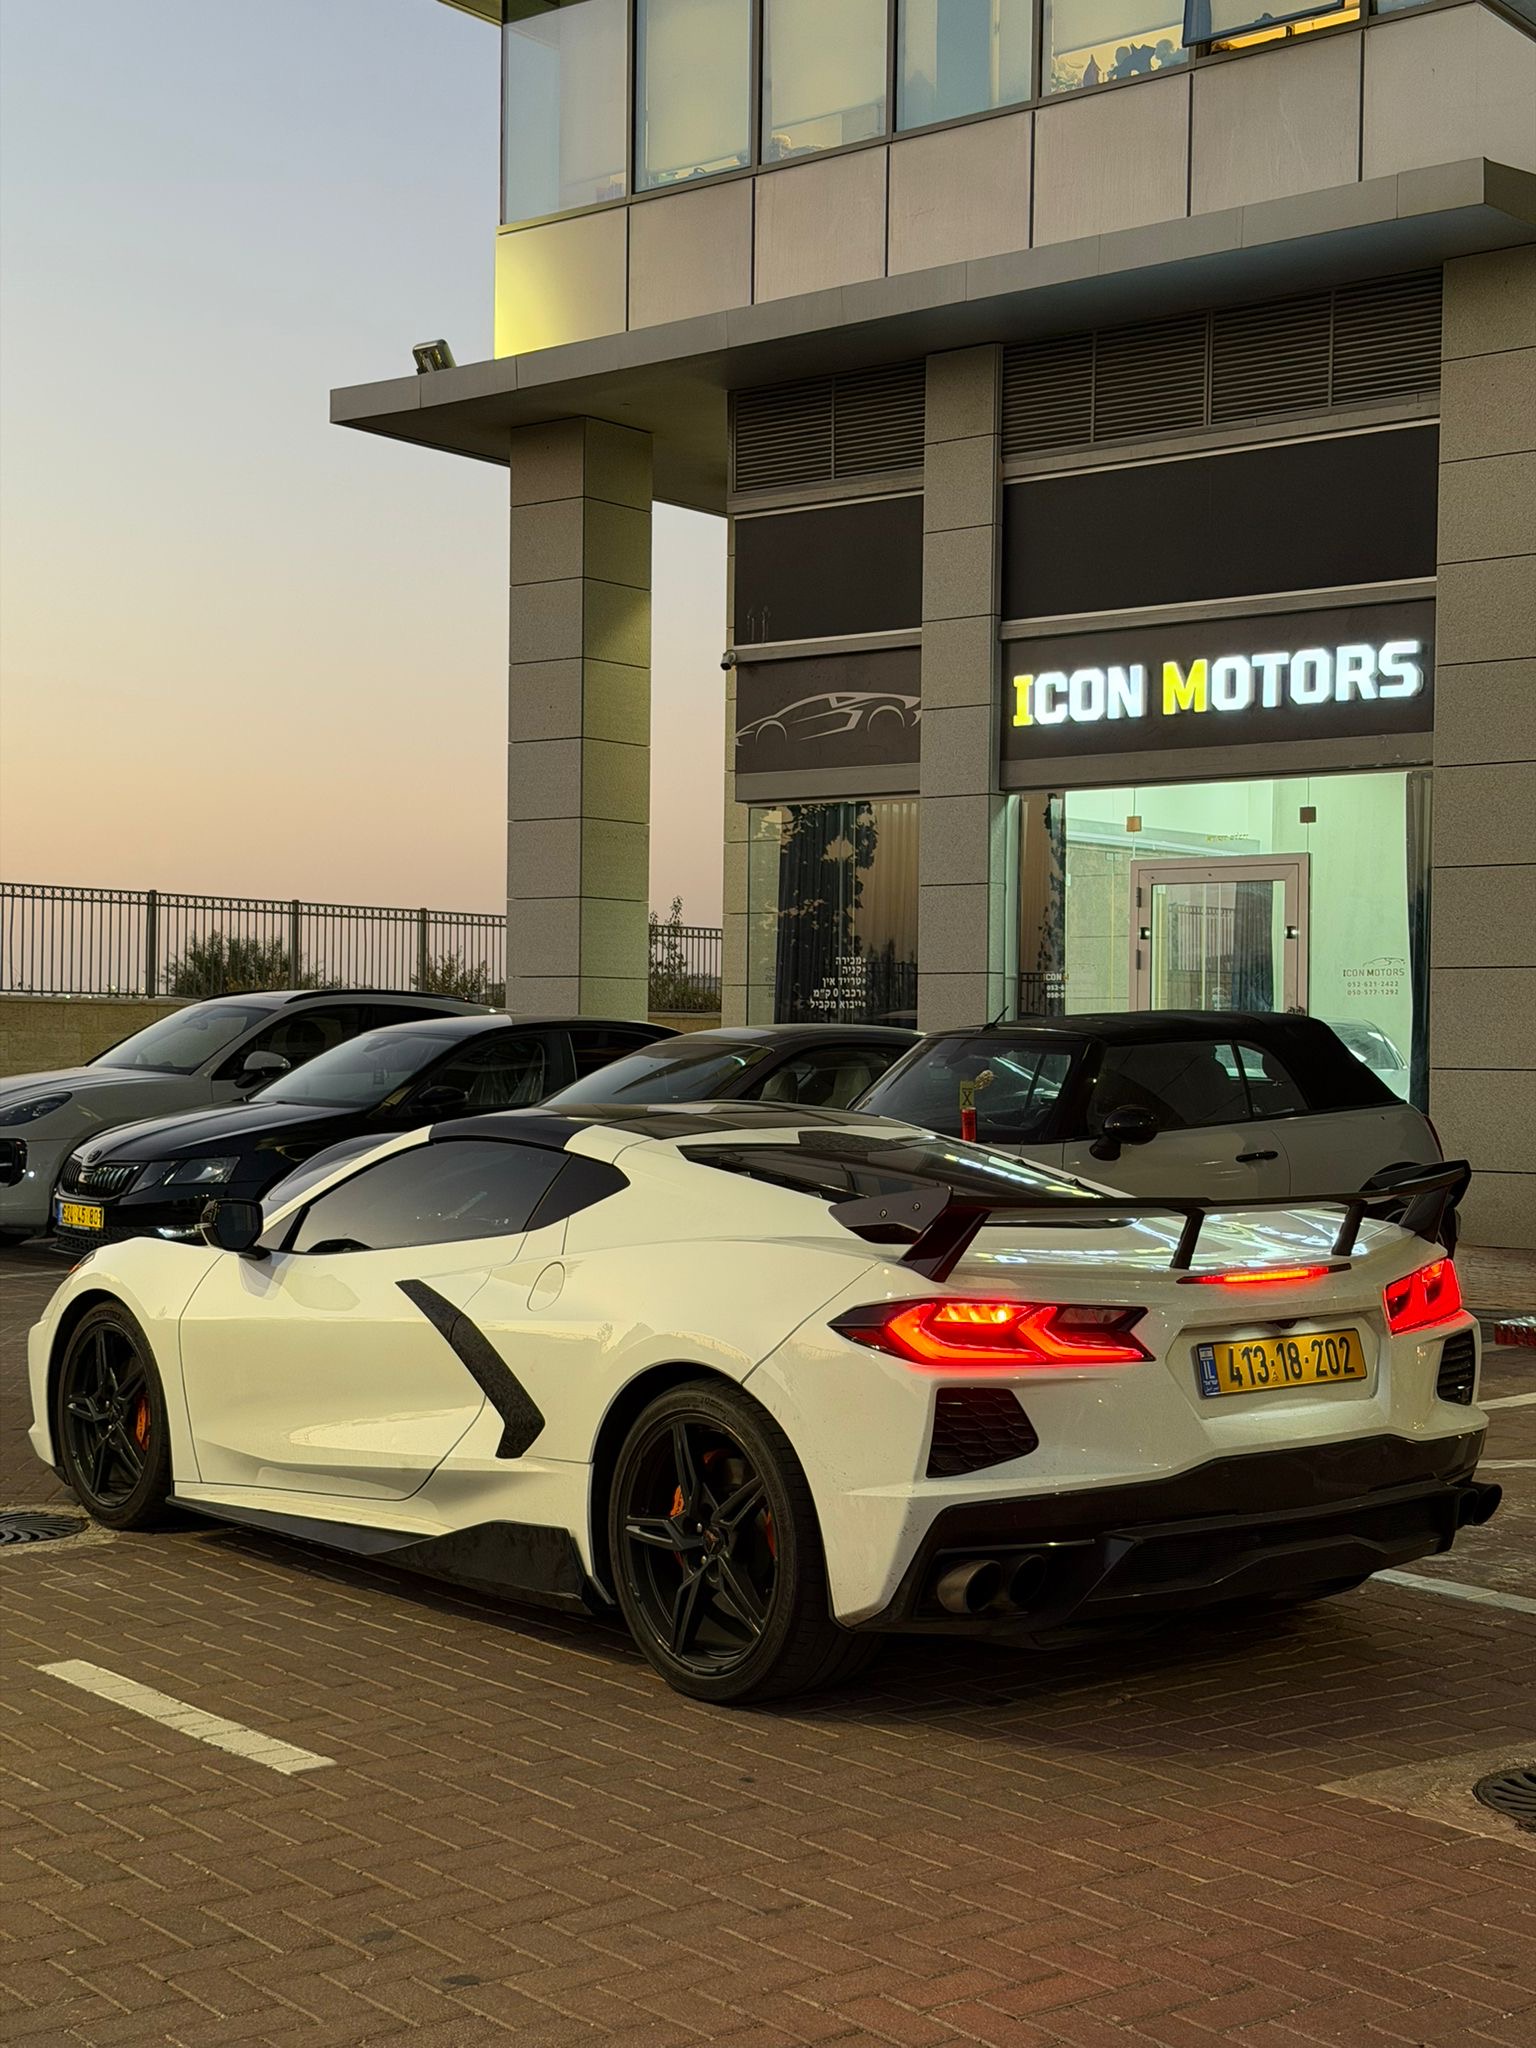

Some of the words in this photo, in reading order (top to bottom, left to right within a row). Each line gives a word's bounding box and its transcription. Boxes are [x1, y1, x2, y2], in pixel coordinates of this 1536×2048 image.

[1012, 664, 1145, 727] ICON
[1162, 639, 1425, 716] MOTORS
[835, 956, 862, 965] מכירה
[842, 966, 862, 977] קניה
[1343, 968, 1365, 977] ICON
[1366, 967, 1406, 977] MOTORS
[822, 977, 836, 988] אין
[838, 977, 862, 986] טרייד
[841, 988, 862, 998] רכבי
[810, 997, 837, 1011] מקביל
[839, 1000, 862, 1009] ייבוא
[1203, 1360, 1216, 1380] IL
